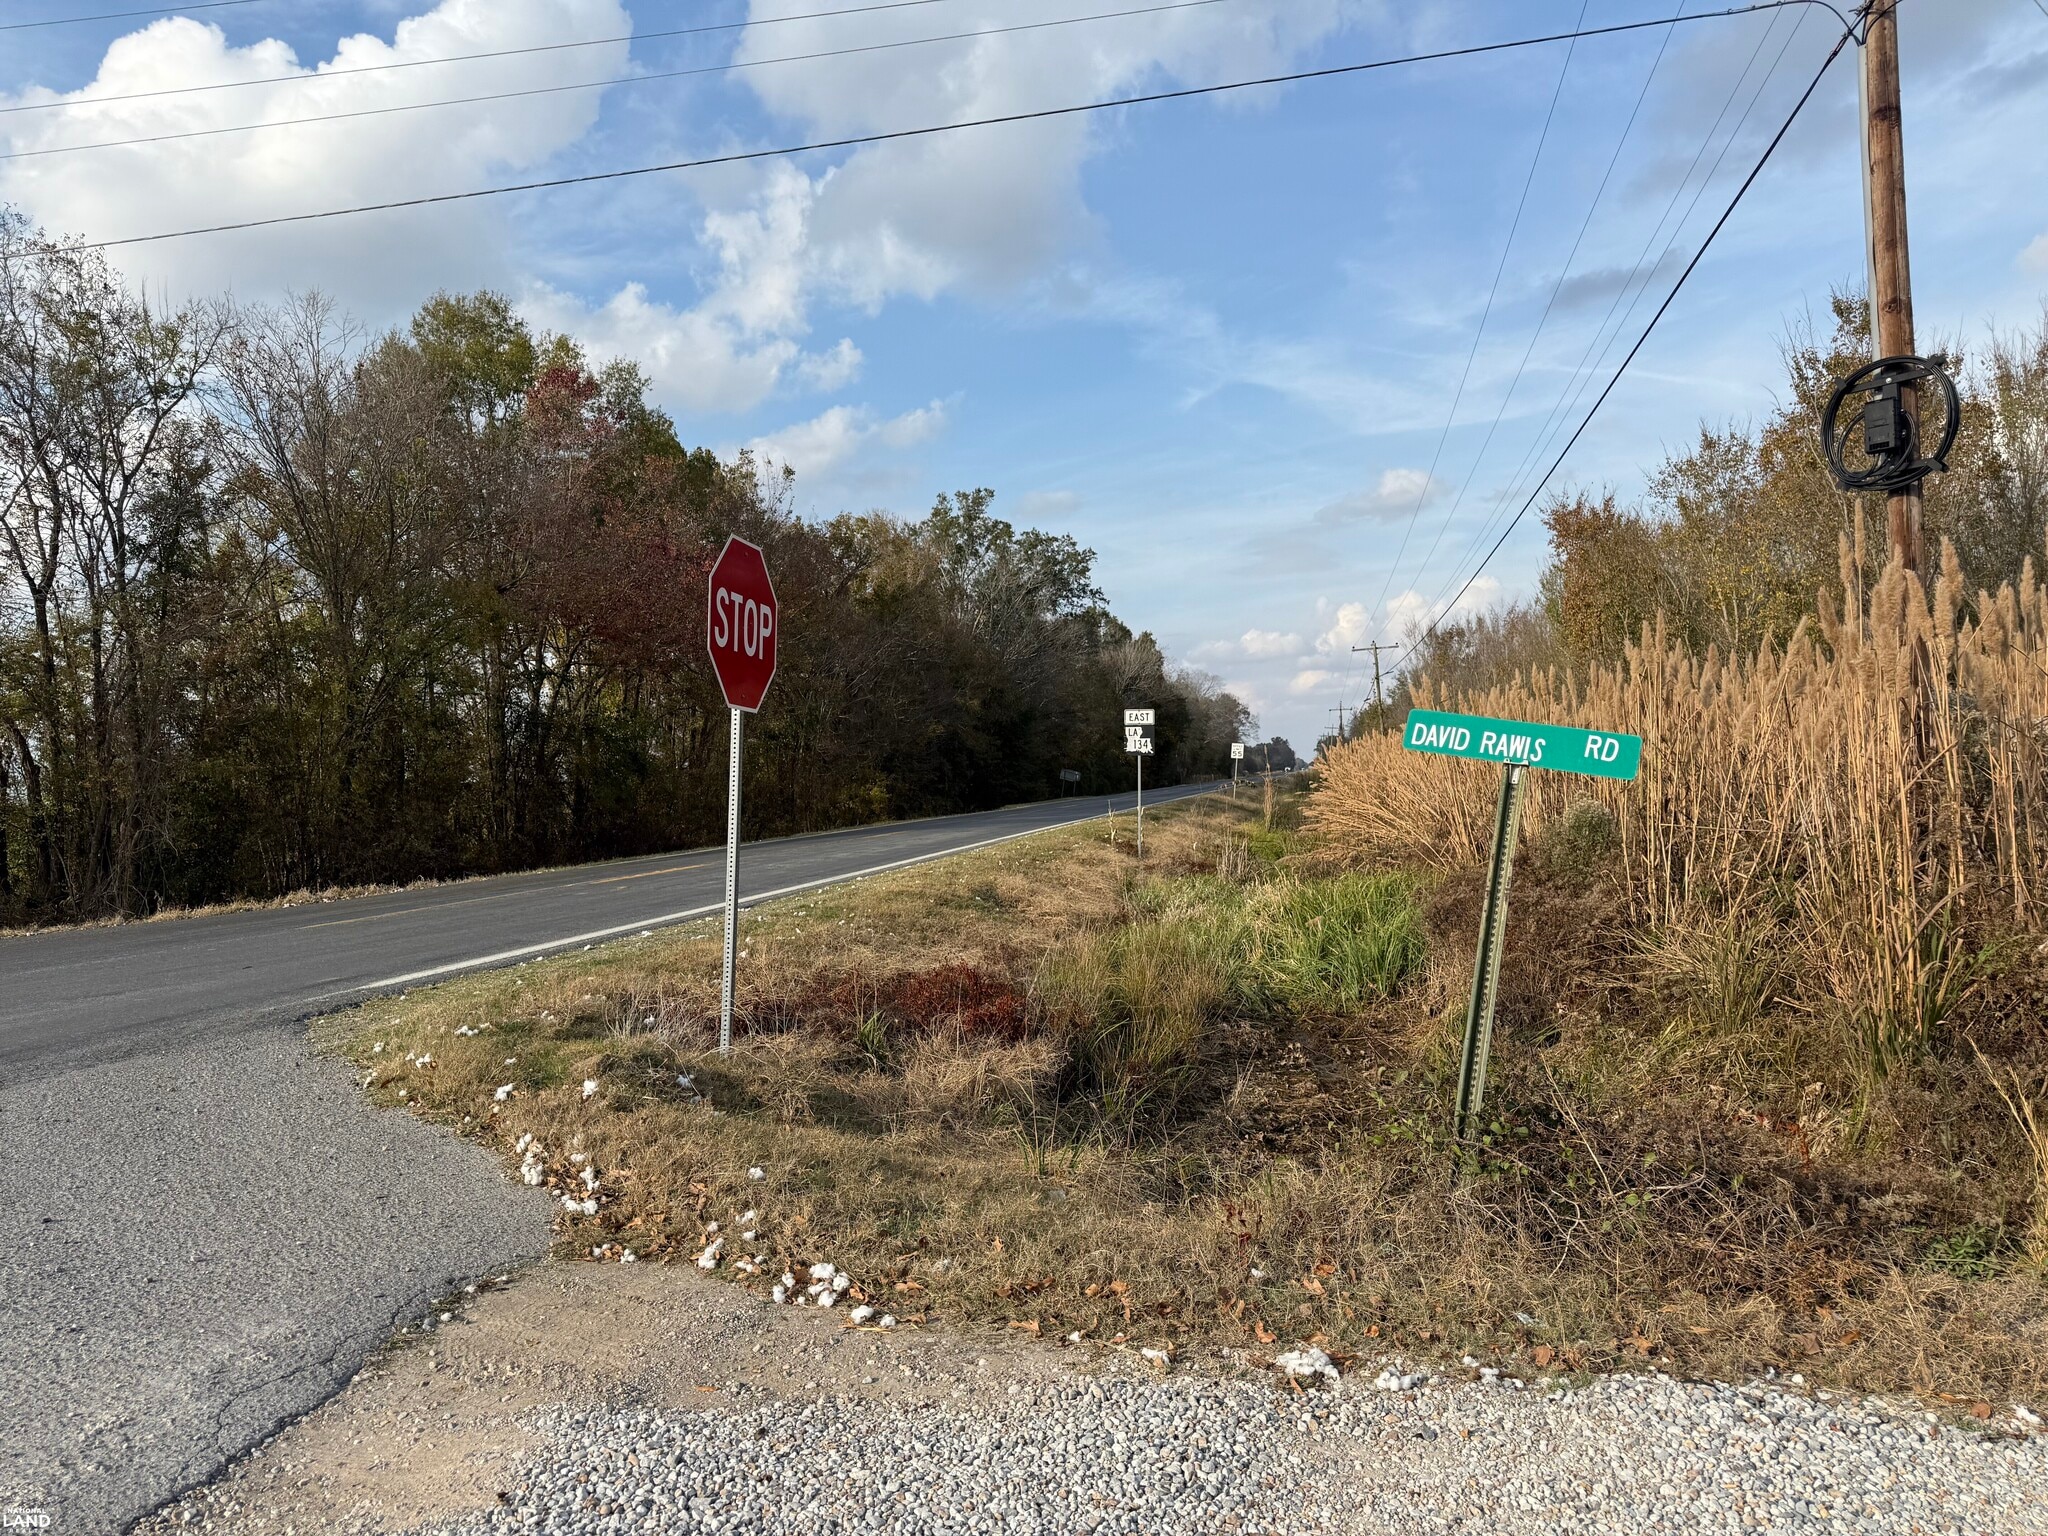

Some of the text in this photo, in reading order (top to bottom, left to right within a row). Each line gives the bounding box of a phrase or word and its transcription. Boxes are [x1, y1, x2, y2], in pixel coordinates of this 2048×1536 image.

[715, 587, 772, 660] STOP
[1129, 713, 1149, 721] EAST
[1129, 728, 1138, 736] LA
[1134, 740, 1148, 749] 134
[1411, 723, 1470, 751] DAVID
[1584, 735, 1620, 762] RD
